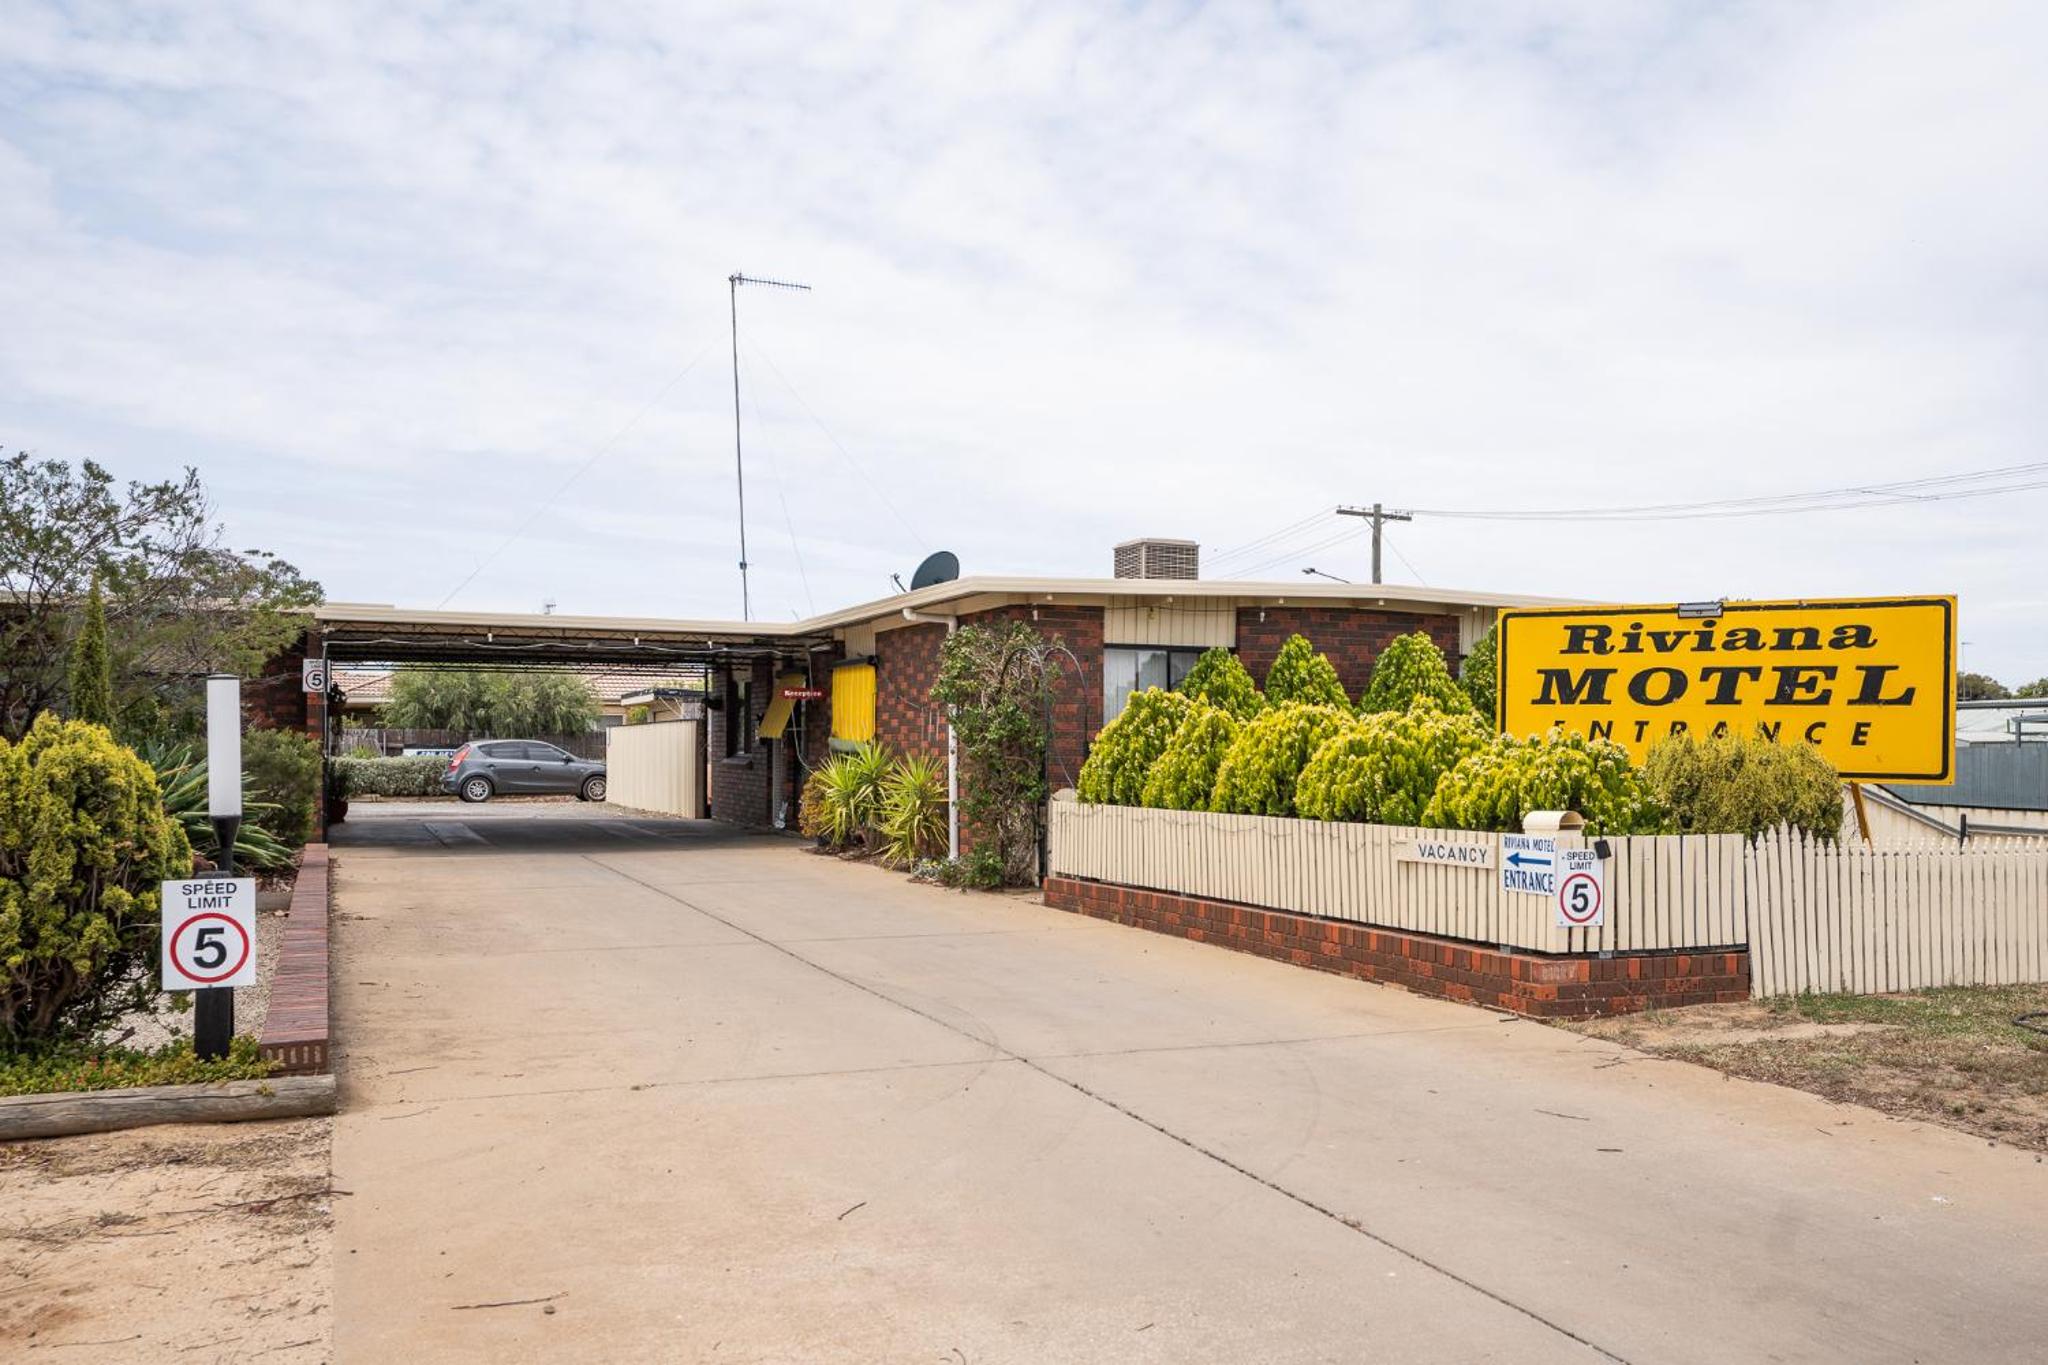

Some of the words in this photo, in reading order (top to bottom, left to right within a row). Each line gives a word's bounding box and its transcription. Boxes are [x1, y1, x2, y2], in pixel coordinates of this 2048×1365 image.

[1559, 620, 1877, 655] Riviana
[312, 674, 322, 686] 5
[1530, 666, 1915, 706] MOTEL
[1504, 836, 1530, 851] RIVIANA
[1532, 838, 1554, 852] MOTEL
[1418, 844, 1487, 864] VACANCY
[1566, 851, 1595, 861] SPEED
[1569, 861, 1592, 870] LIMIT
[182, 882, 237, 896] SPEED
[1504, 869, 1554, 893] ENTRANCE
[189, 897, 232, 909] LIMIT
[1571, 883, 1589, 913] 5
[193, 926, 227, 969] 5
